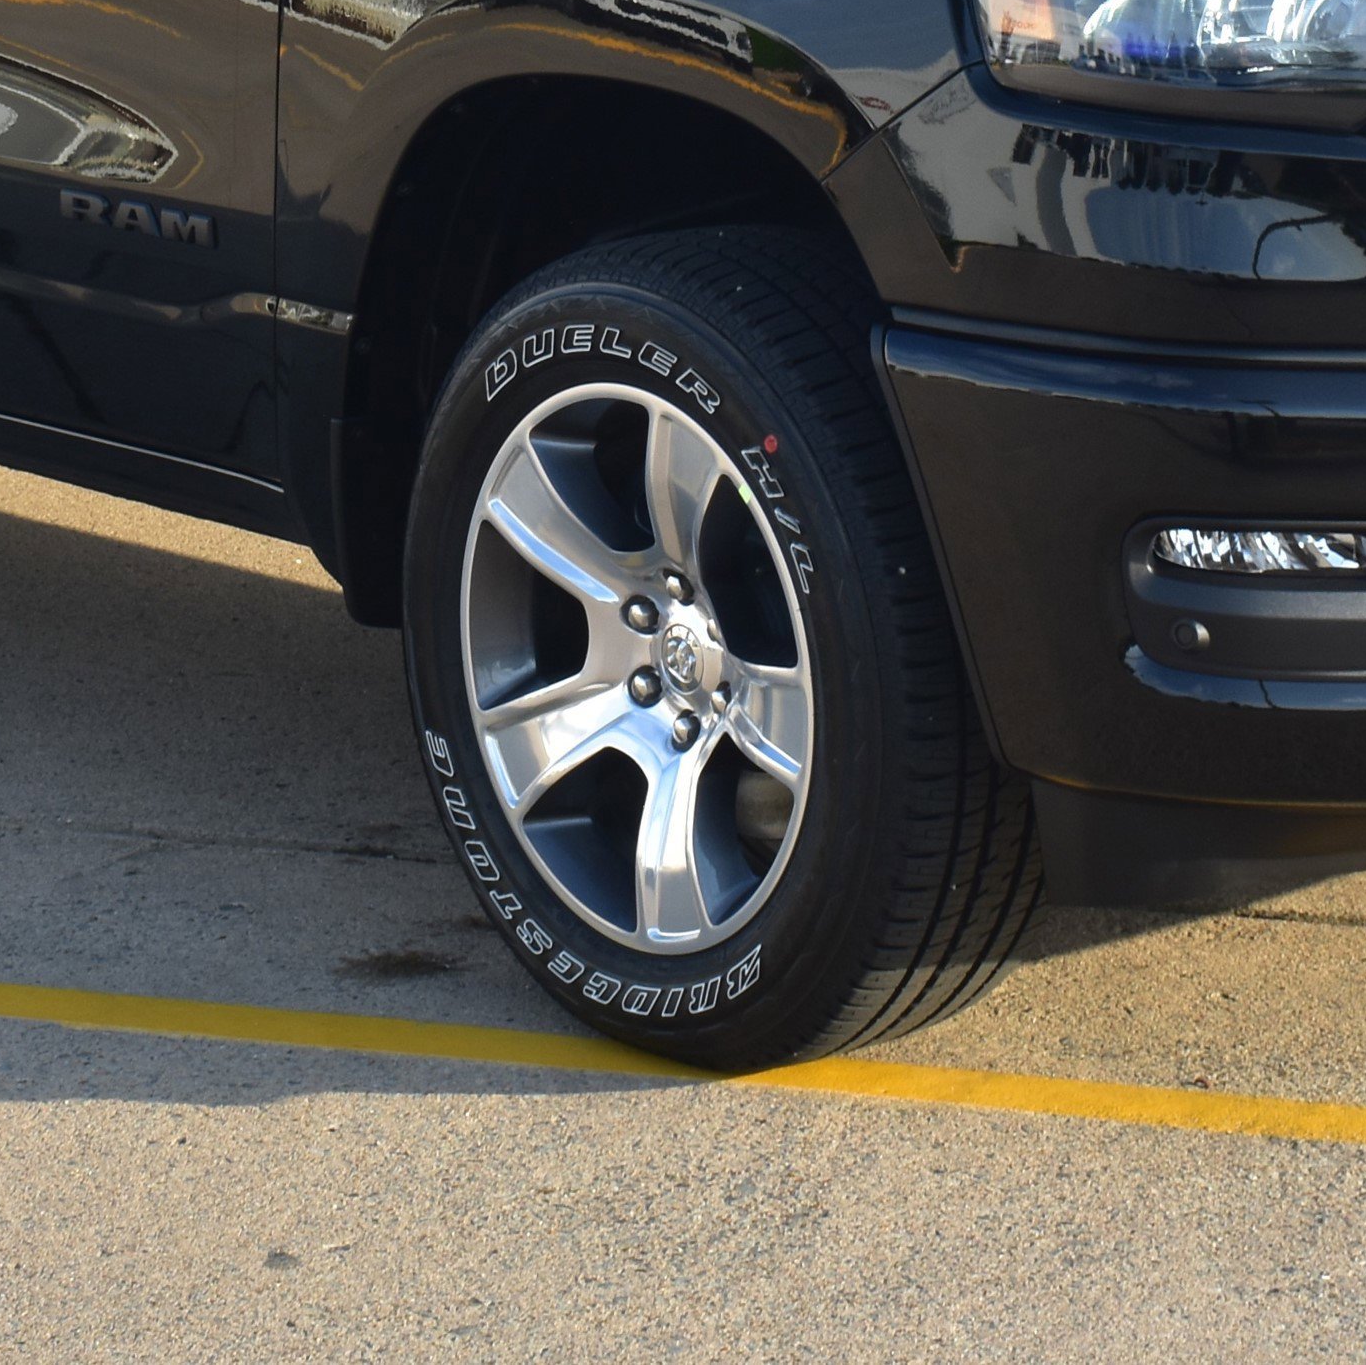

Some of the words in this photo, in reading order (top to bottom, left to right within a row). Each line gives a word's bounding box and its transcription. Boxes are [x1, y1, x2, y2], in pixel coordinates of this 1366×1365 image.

[59, 188, 218, 249] RAM
[485, 324, 720, 415] DUELER
[741, 446, 814, 594] H/L
[425, 730, 763, 1017] BRIDGESTONE
